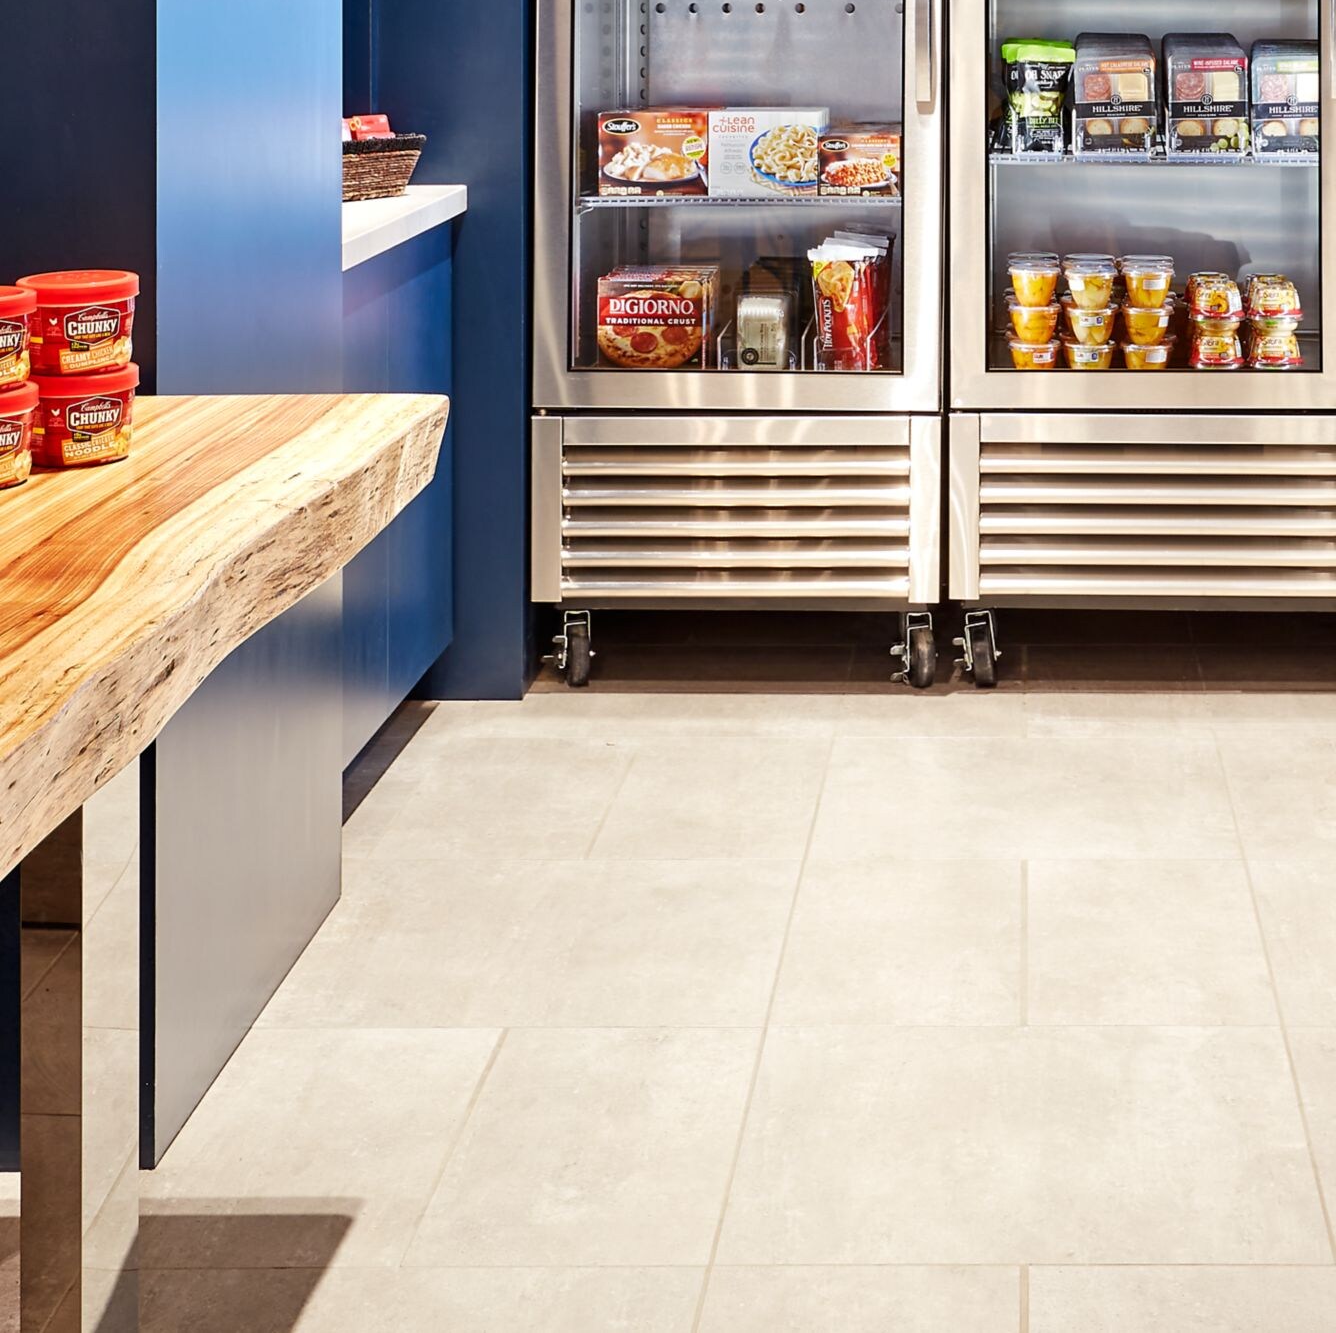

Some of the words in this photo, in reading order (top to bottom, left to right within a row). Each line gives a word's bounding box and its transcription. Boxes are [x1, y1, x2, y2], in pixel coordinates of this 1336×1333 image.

[1092, 104, 1141, 113] HILLSHIRE
[1183, 105, 1233, 113] HILLSHIRE
[1269, 106, 1318, 114] HILLSHIRE
[609, 299, 694, 315] DIGIORNO
[67, 318, 118, 336] CHUNKY
[605, 317, 665, 325] TRADITIONAL
[0, 333, 20, 348] NKY
[70, 408, 120, 427] CHUNKY
[0, 431, 20, 446] NKY
